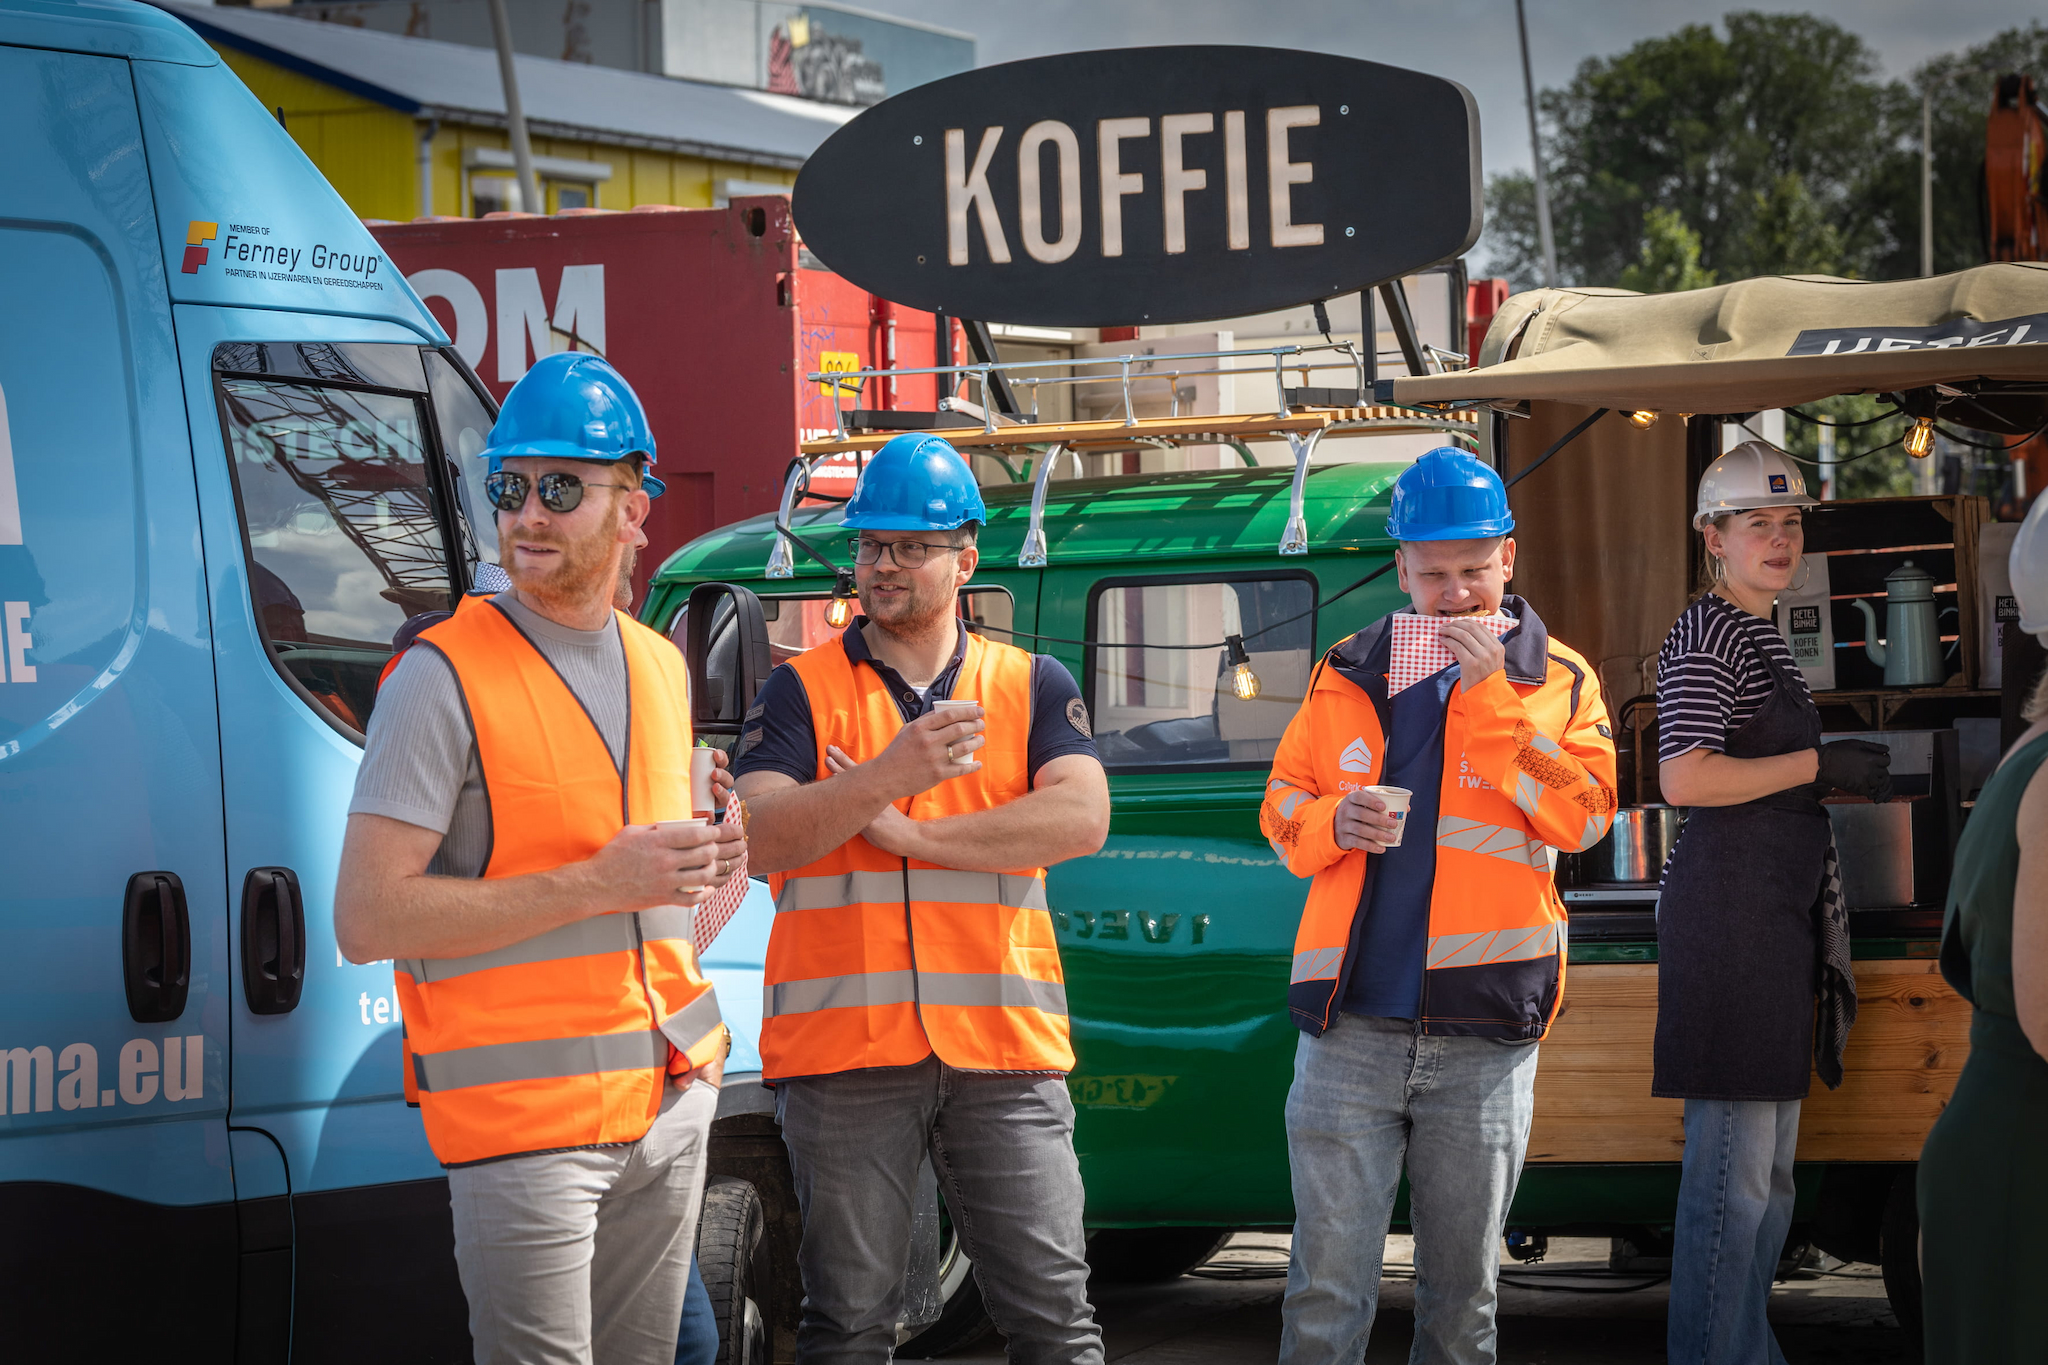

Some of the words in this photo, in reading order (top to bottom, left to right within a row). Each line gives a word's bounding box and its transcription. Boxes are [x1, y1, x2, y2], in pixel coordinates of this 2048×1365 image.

[944, 105, 1325, 266] KOFFIE
[229, 224, 261, 235] MEMBER
[261, 227, 271, 236] OF
[224, 235, 301, 272] Ferney
[225, 268, 257, 280] PARTNER
[258, 272, 267, 280] IN
[312, 277, 323, 285] EN
[324, 277, 384, 291] GEREEDSCHAPPEN
[1792, 609, 1817, 619] KETEL
[1793, 619, 1818, 629] BINKIE
[1794, 637, 1819, 648] KOFFIE
[1794, 647, 1819, 658] BONEN
